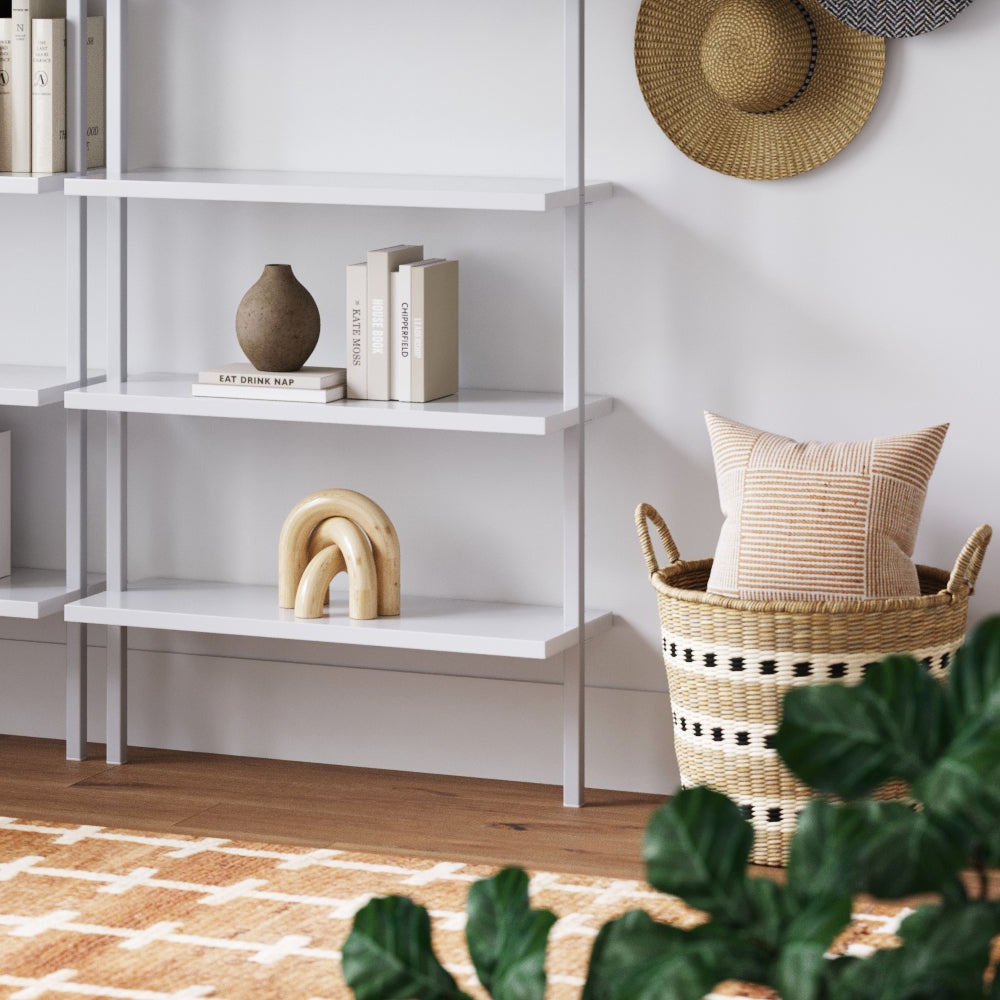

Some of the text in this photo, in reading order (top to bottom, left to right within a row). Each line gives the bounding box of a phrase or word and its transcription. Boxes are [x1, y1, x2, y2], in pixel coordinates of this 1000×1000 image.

[352, 309, 361, 335] KATE
[371, 298, 384, 354] HOUSE BOOK
[401, 302, 409, 358] CHIPPERFIELD
[352, 338, 361, 366] MOSS
[219, 374, 295, 387] EAT DRINK NAP
